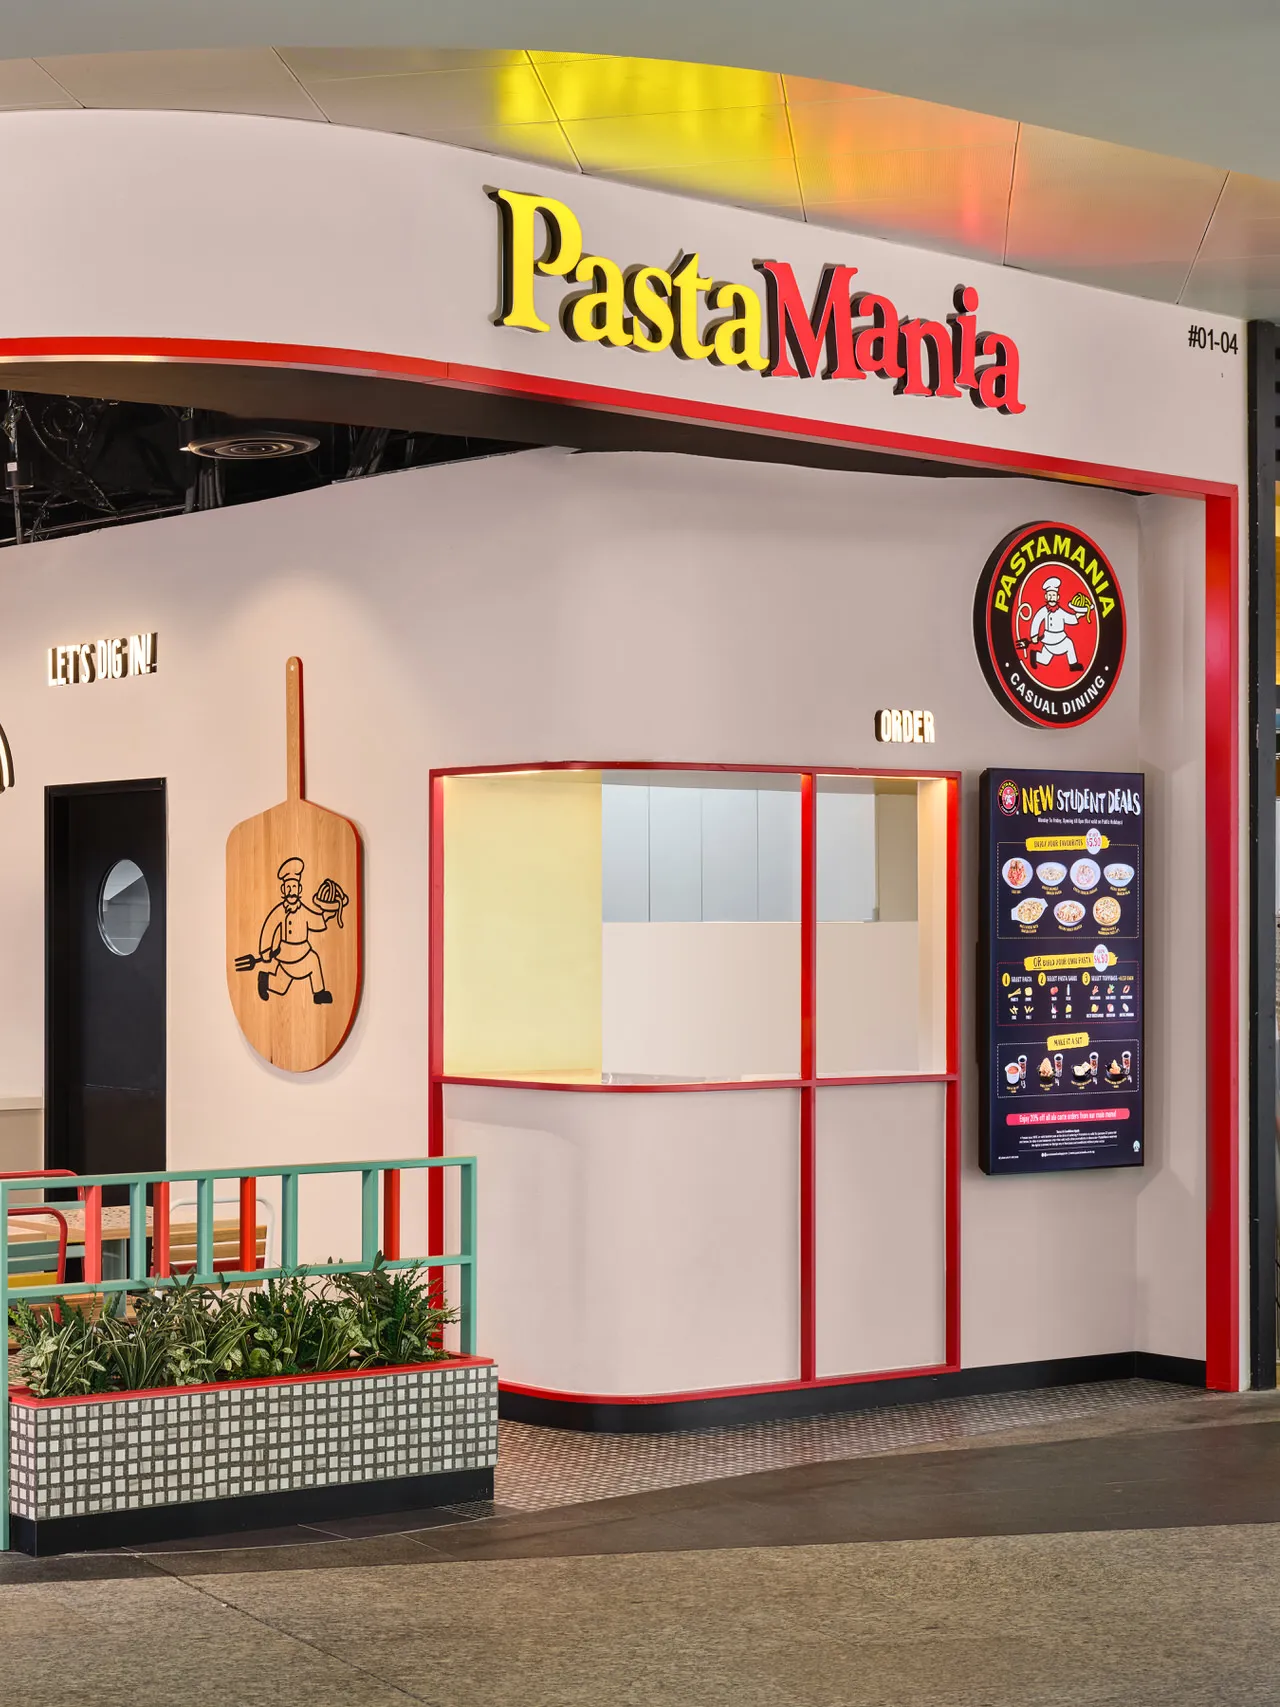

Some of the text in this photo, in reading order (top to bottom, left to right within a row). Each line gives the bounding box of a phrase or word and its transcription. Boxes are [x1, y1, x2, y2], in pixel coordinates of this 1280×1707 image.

[498, 189, 1026, 415] PastaMania
[1188, 325, 1239, 355] #01-04
[994, 534, 1116, 618] PASTAMANIA
[48, 632, 156, 687] LET'S DIG IN!
[1010, 672, 1106, 715] CASUAL DINING
[878, 709, 936, 743] ORDER
[1022, 784, 1141, 816] NEW STUDENT DEALS
[1033, 956, 1042, 967] OR
